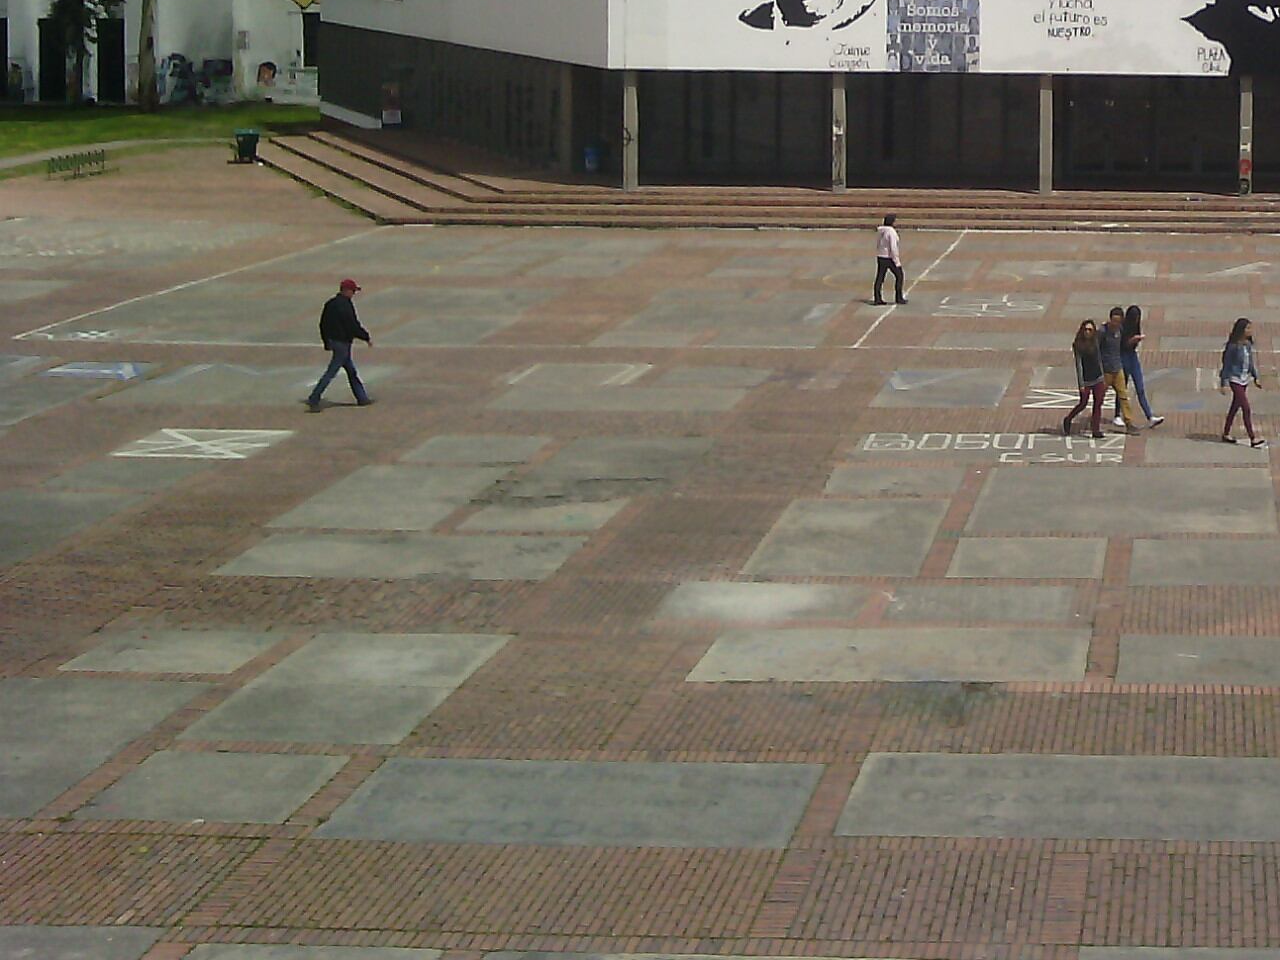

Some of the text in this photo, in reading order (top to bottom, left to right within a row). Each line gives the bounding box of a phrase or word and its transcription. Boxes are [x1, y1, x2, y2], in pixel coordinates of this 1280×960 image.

[906, 3, 960, 17] Somos
[1049, 11, 1090, 25] futuro
[897, 21, 970, 33] memoria
